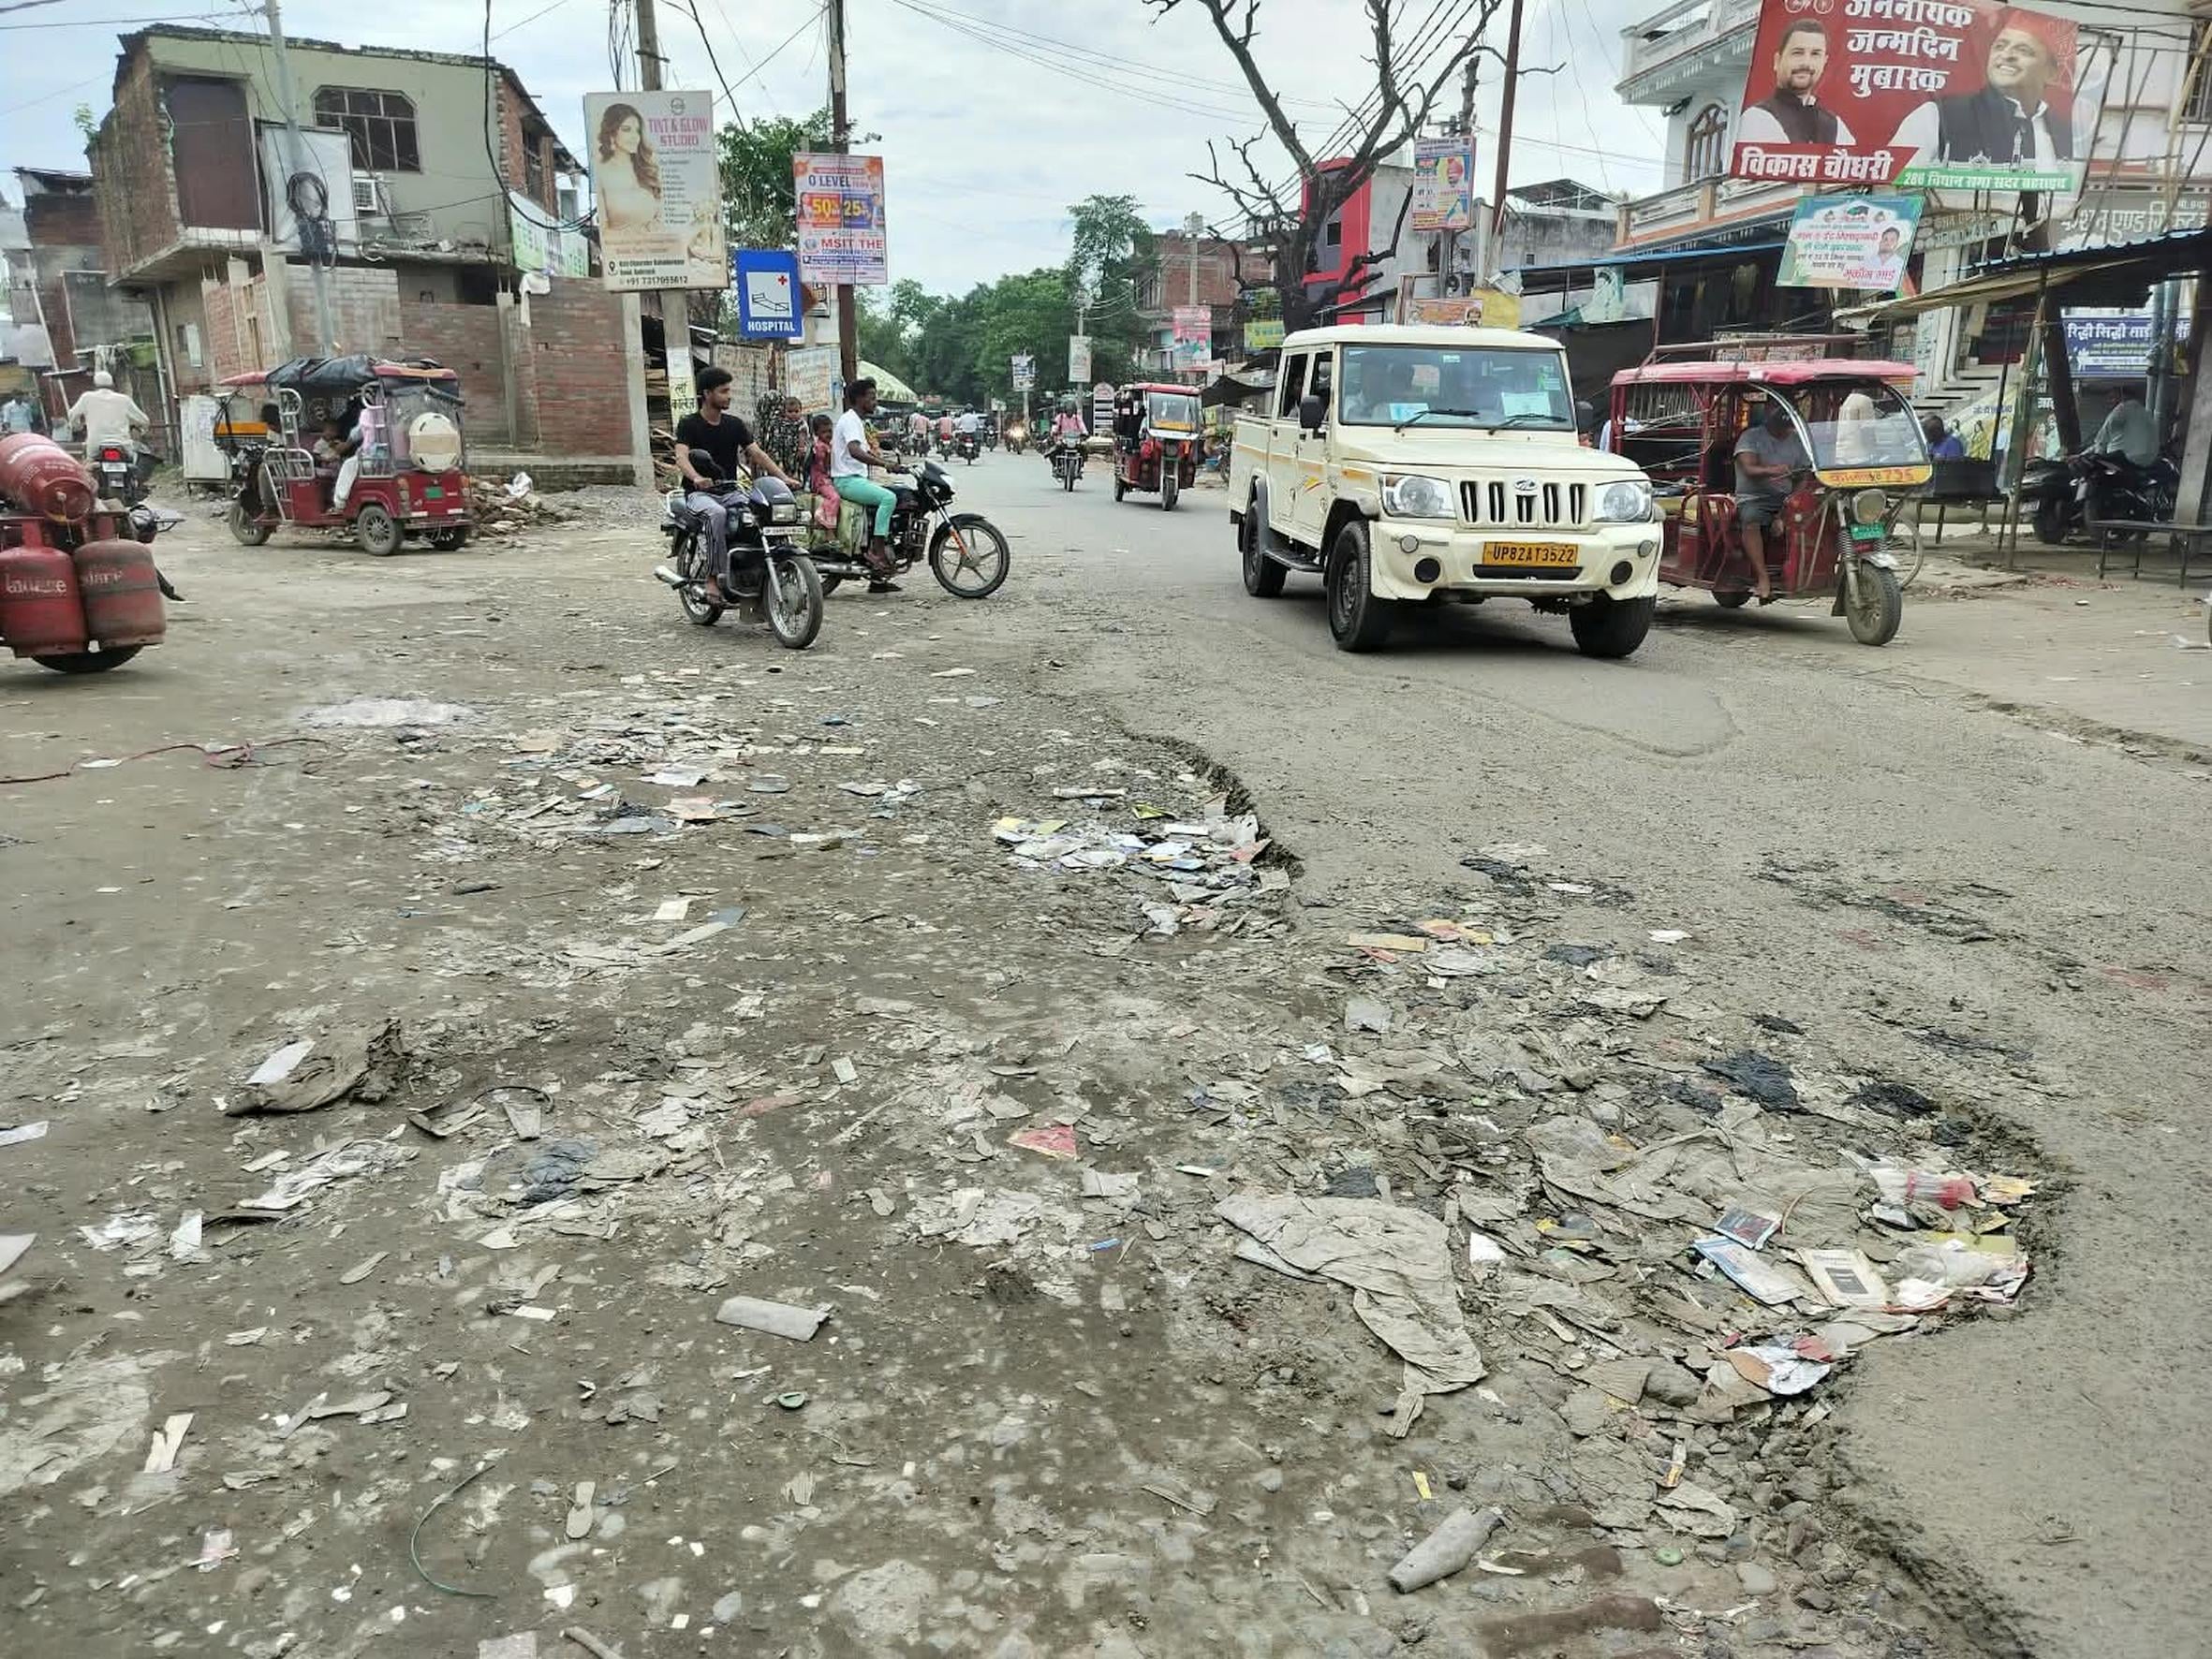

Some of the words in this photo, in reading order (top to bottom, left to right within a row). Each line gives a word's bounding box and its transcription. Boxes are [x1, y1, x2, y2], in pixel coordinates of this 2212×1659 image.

[1847, 26, 1964, 62] जन्मदिन
[1851, 65, 1950, 97] मुबारक
[659, 135, 699, 146] STUDIO
[1739, 145, 1821, 178] विकास
[1824, 148, 1894, 181] चौधरी
[819, 175, 850, 186] LEVEL
[859, 240, 884, 248] THE
[747, 320, 795, 331] HOSPITAL
[1493, 544, 1574, 564] UP82AT3522
